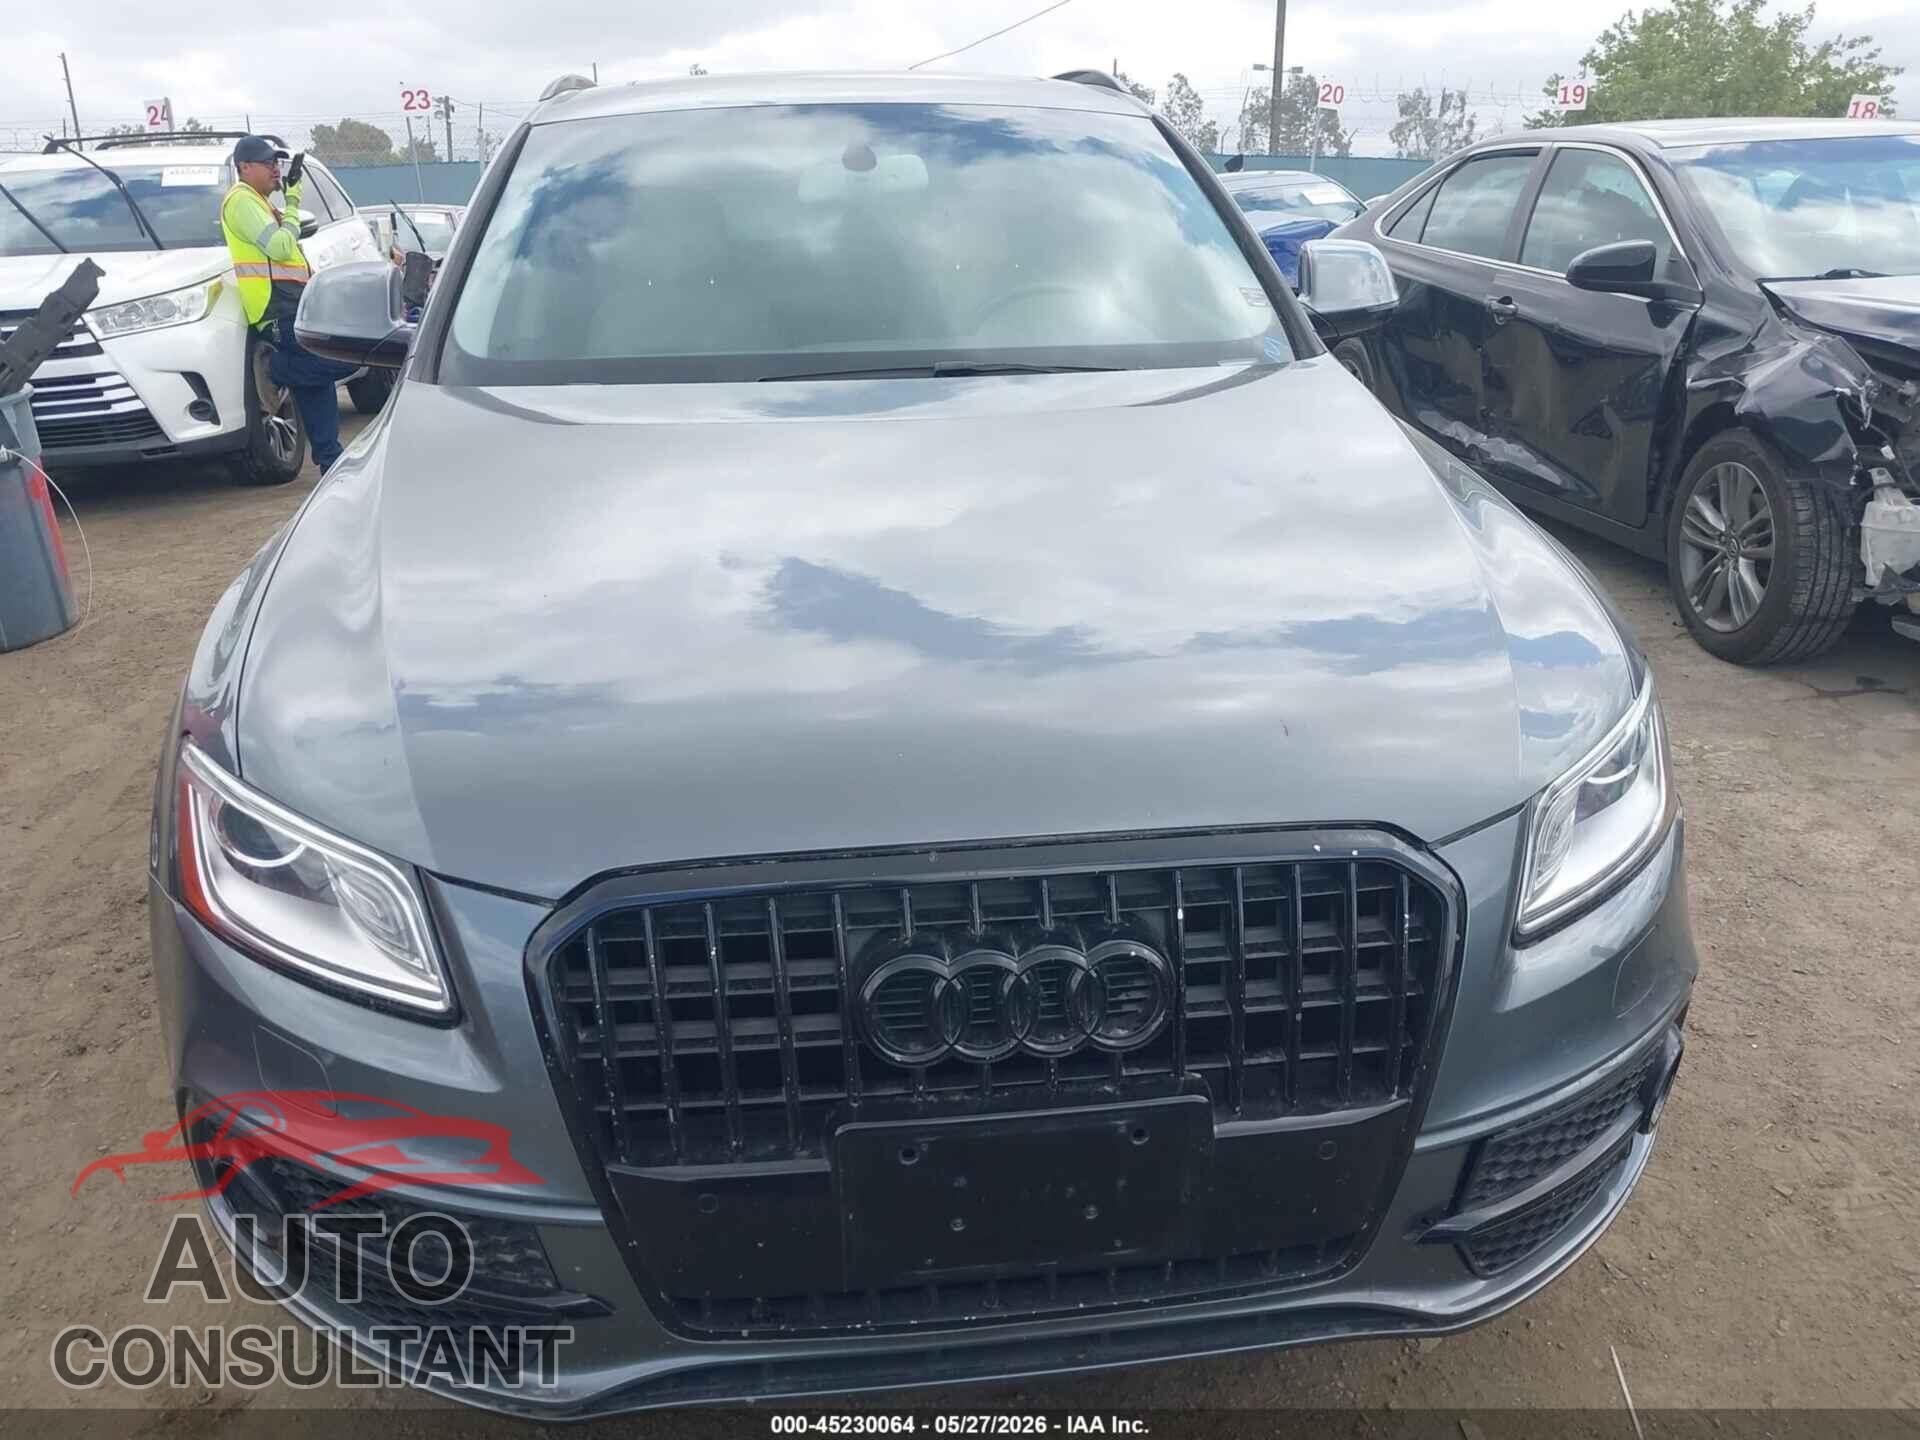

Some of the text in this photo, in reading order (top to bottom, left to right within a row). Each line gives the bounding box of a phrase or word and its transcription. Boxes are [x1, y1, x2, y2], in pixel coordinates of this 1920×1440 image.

[401, 90, 431, 110] 23
[1320, 84, 1344, 104] 20
[1559, 85, 1585, 104] 19
[1848, 101, 1877, 119] 18
